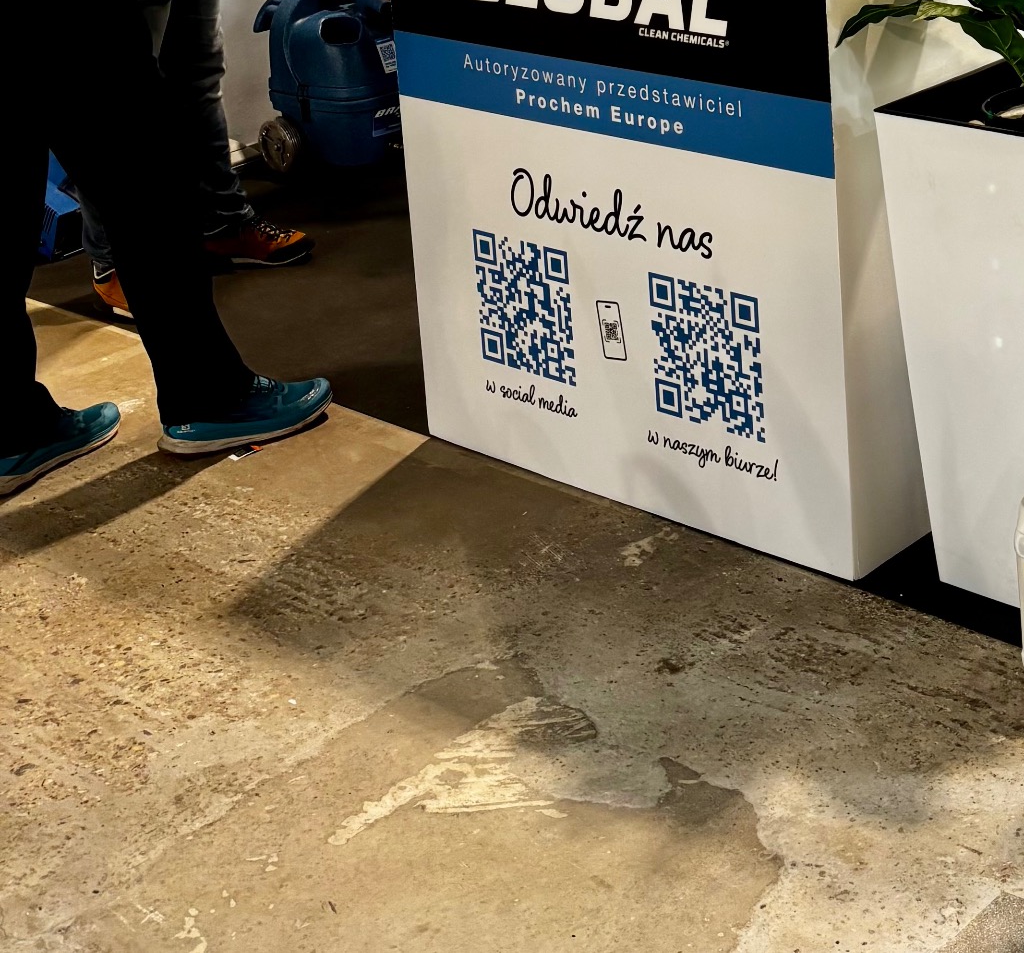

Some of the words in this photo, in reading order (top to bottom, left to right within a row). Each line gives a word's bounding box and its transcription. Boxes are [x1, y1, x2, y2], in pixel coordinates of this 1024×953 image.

[638, 27, 669, 41] CLEAN
[463, 53, 587, 94] Autoryzowany
[596, 78, 743, 119] przedstawiciel
[515, 88, 601, 120] Prochem
[610, 105, 684, 136] Europe
[510, 167, 647, 242] Odwiedź
[656, 221, 714, 260] nas
[485, 379, 496, 393] w
[500, 384, 536, 406] social
[538, 394, 578, 418] media
[647, 429, 660, 446] w
[662, 436, 722, 468] naszym
[724, 446, 780, 482] biurze!
